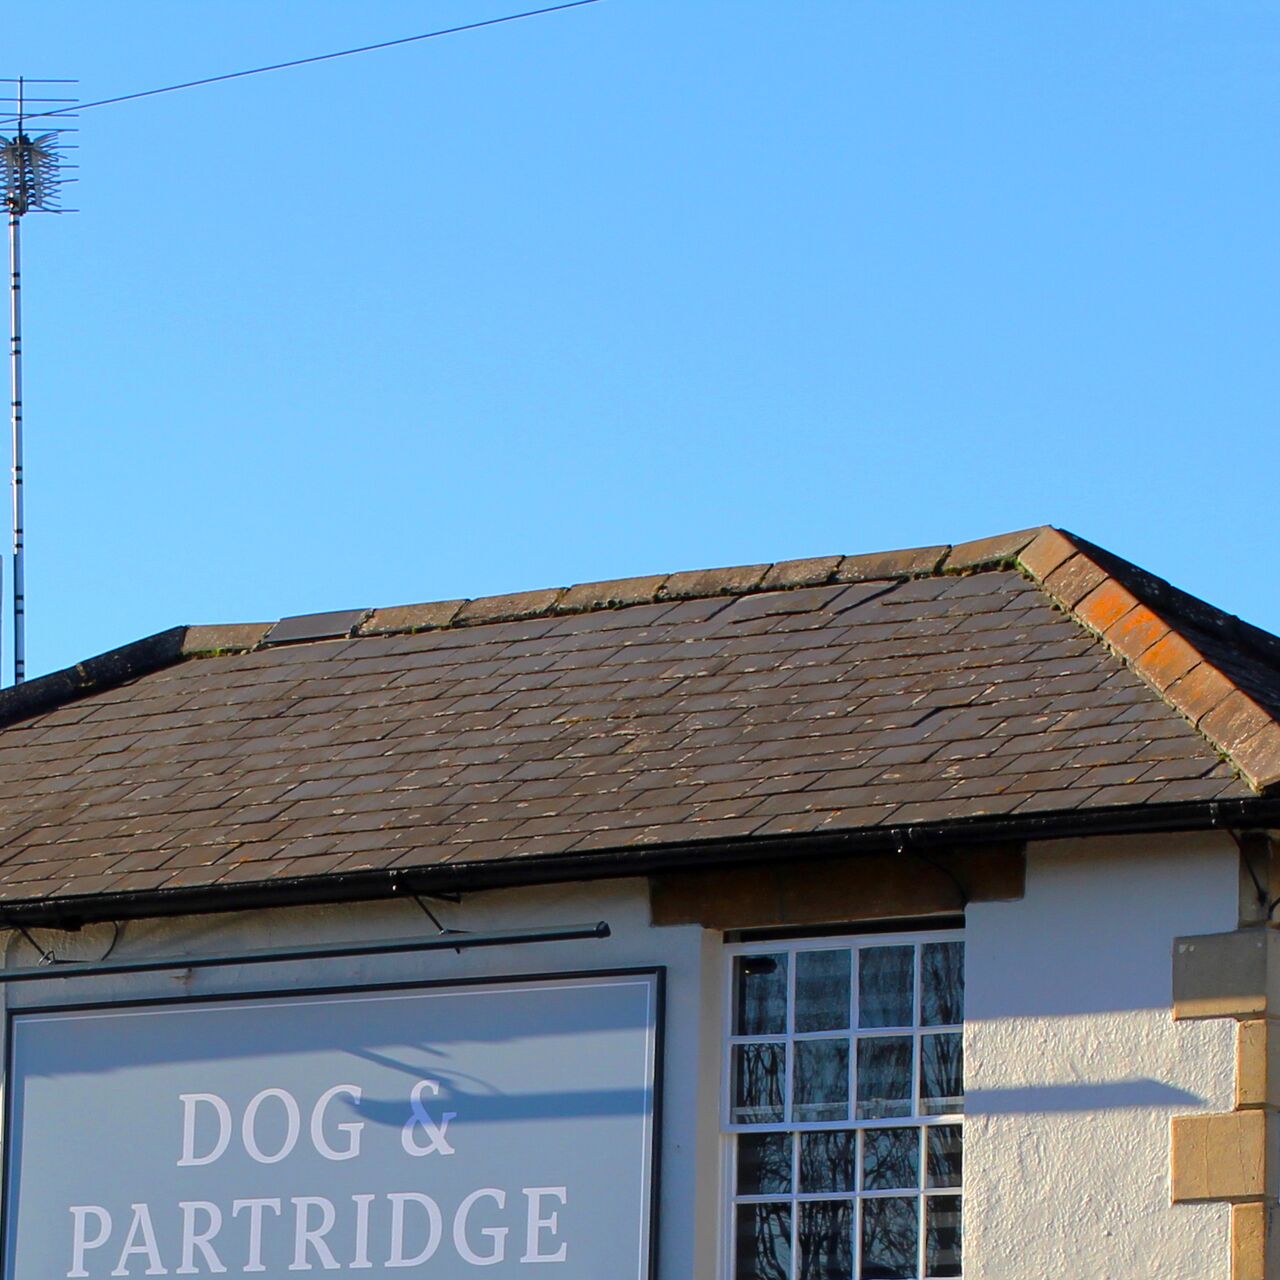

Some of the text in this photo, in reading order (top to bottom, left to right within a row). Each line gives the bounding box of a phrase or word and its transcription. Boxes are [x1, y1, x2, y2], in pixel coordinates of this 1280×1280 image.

[177, 1080, 457, 1167] DOG &
[67, 1187, 568, 1278] PARTRIDGE
